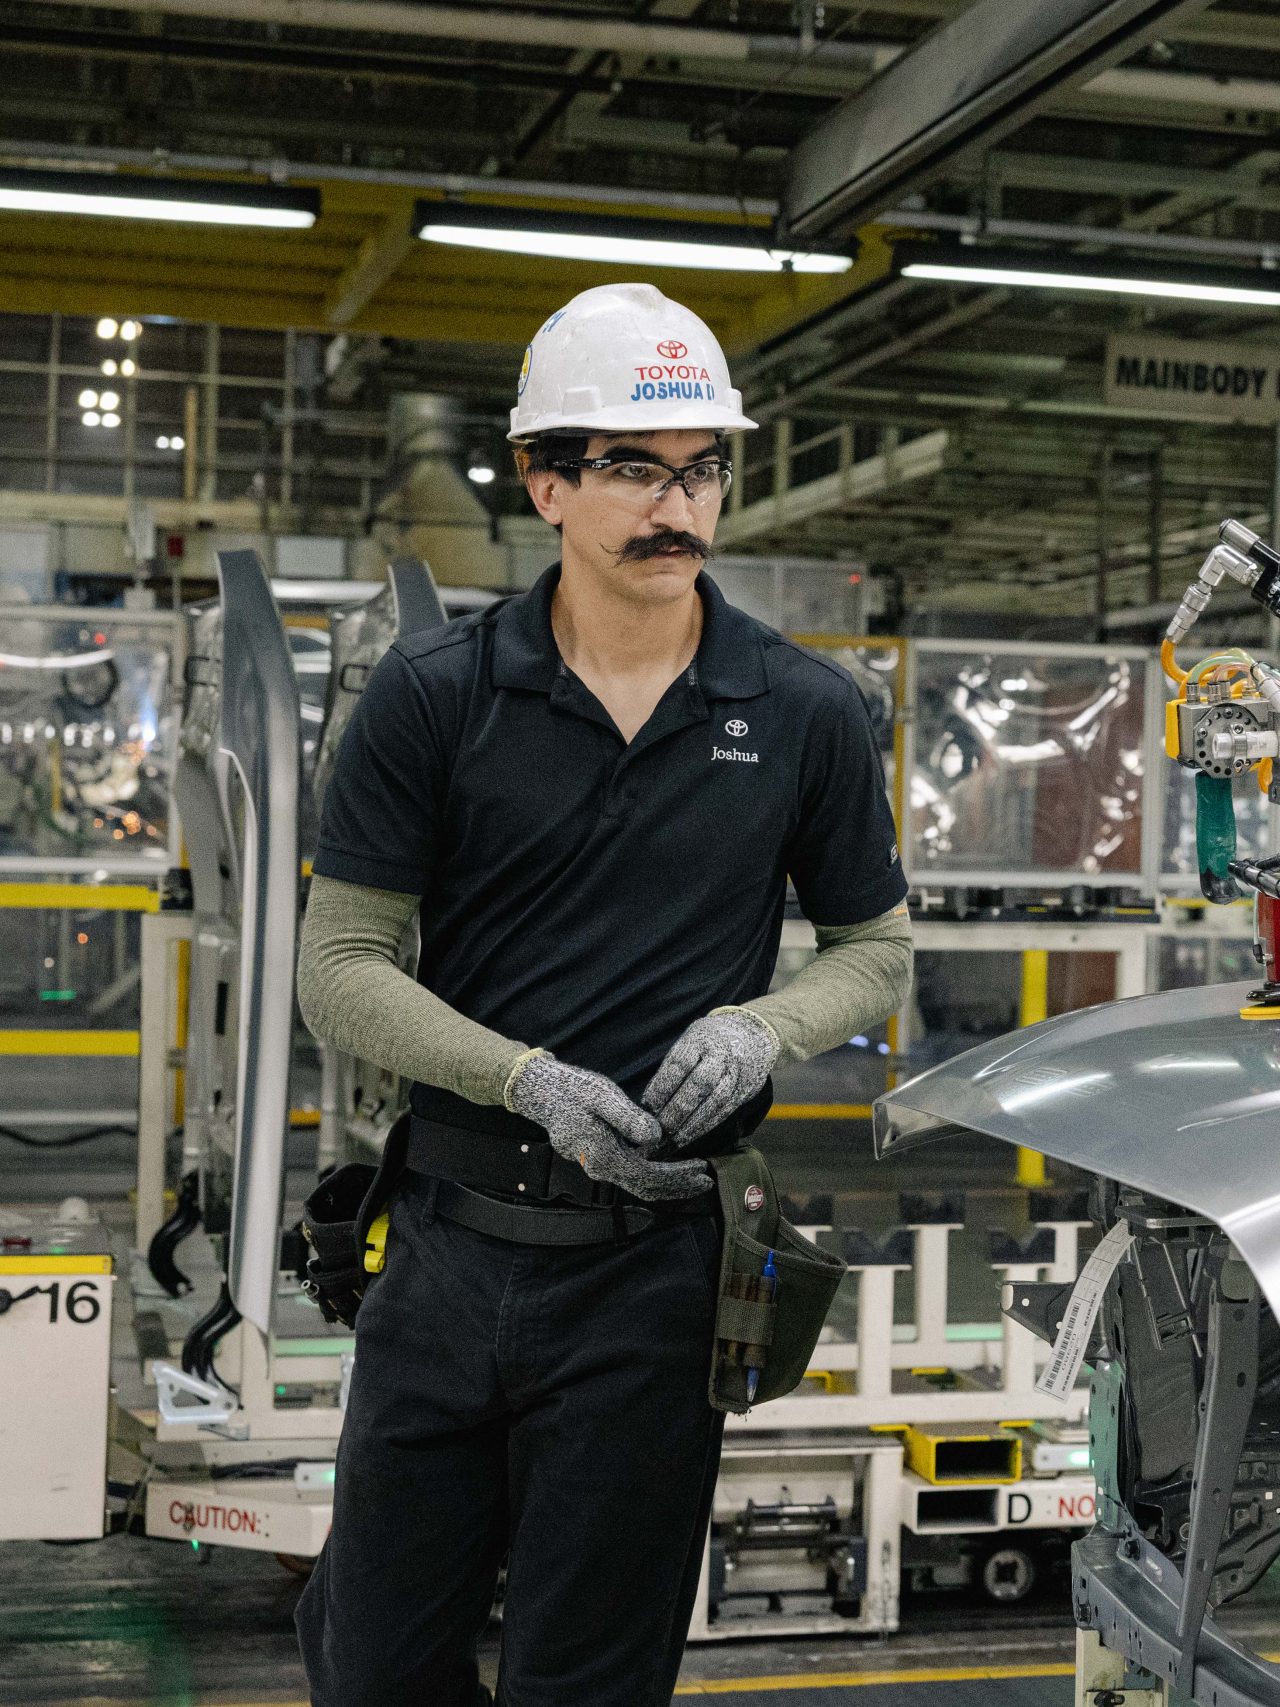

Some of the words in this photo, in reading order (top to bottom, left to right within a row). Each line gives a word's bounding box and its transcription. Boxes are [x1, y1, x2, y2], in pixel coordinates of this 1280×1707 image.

[634, 365, 711, 381] TOYOTA
[1116, 355, 1268, 398] MAINBODY
[631, 382, 703, 401] JOSHUA
[711, 747, 759, 762] Joshua
[42, 1282, 100, 1324] 16
[1008, 1493, 1032, 1523] D
[1058, 1495, 1096, 1518] NO
